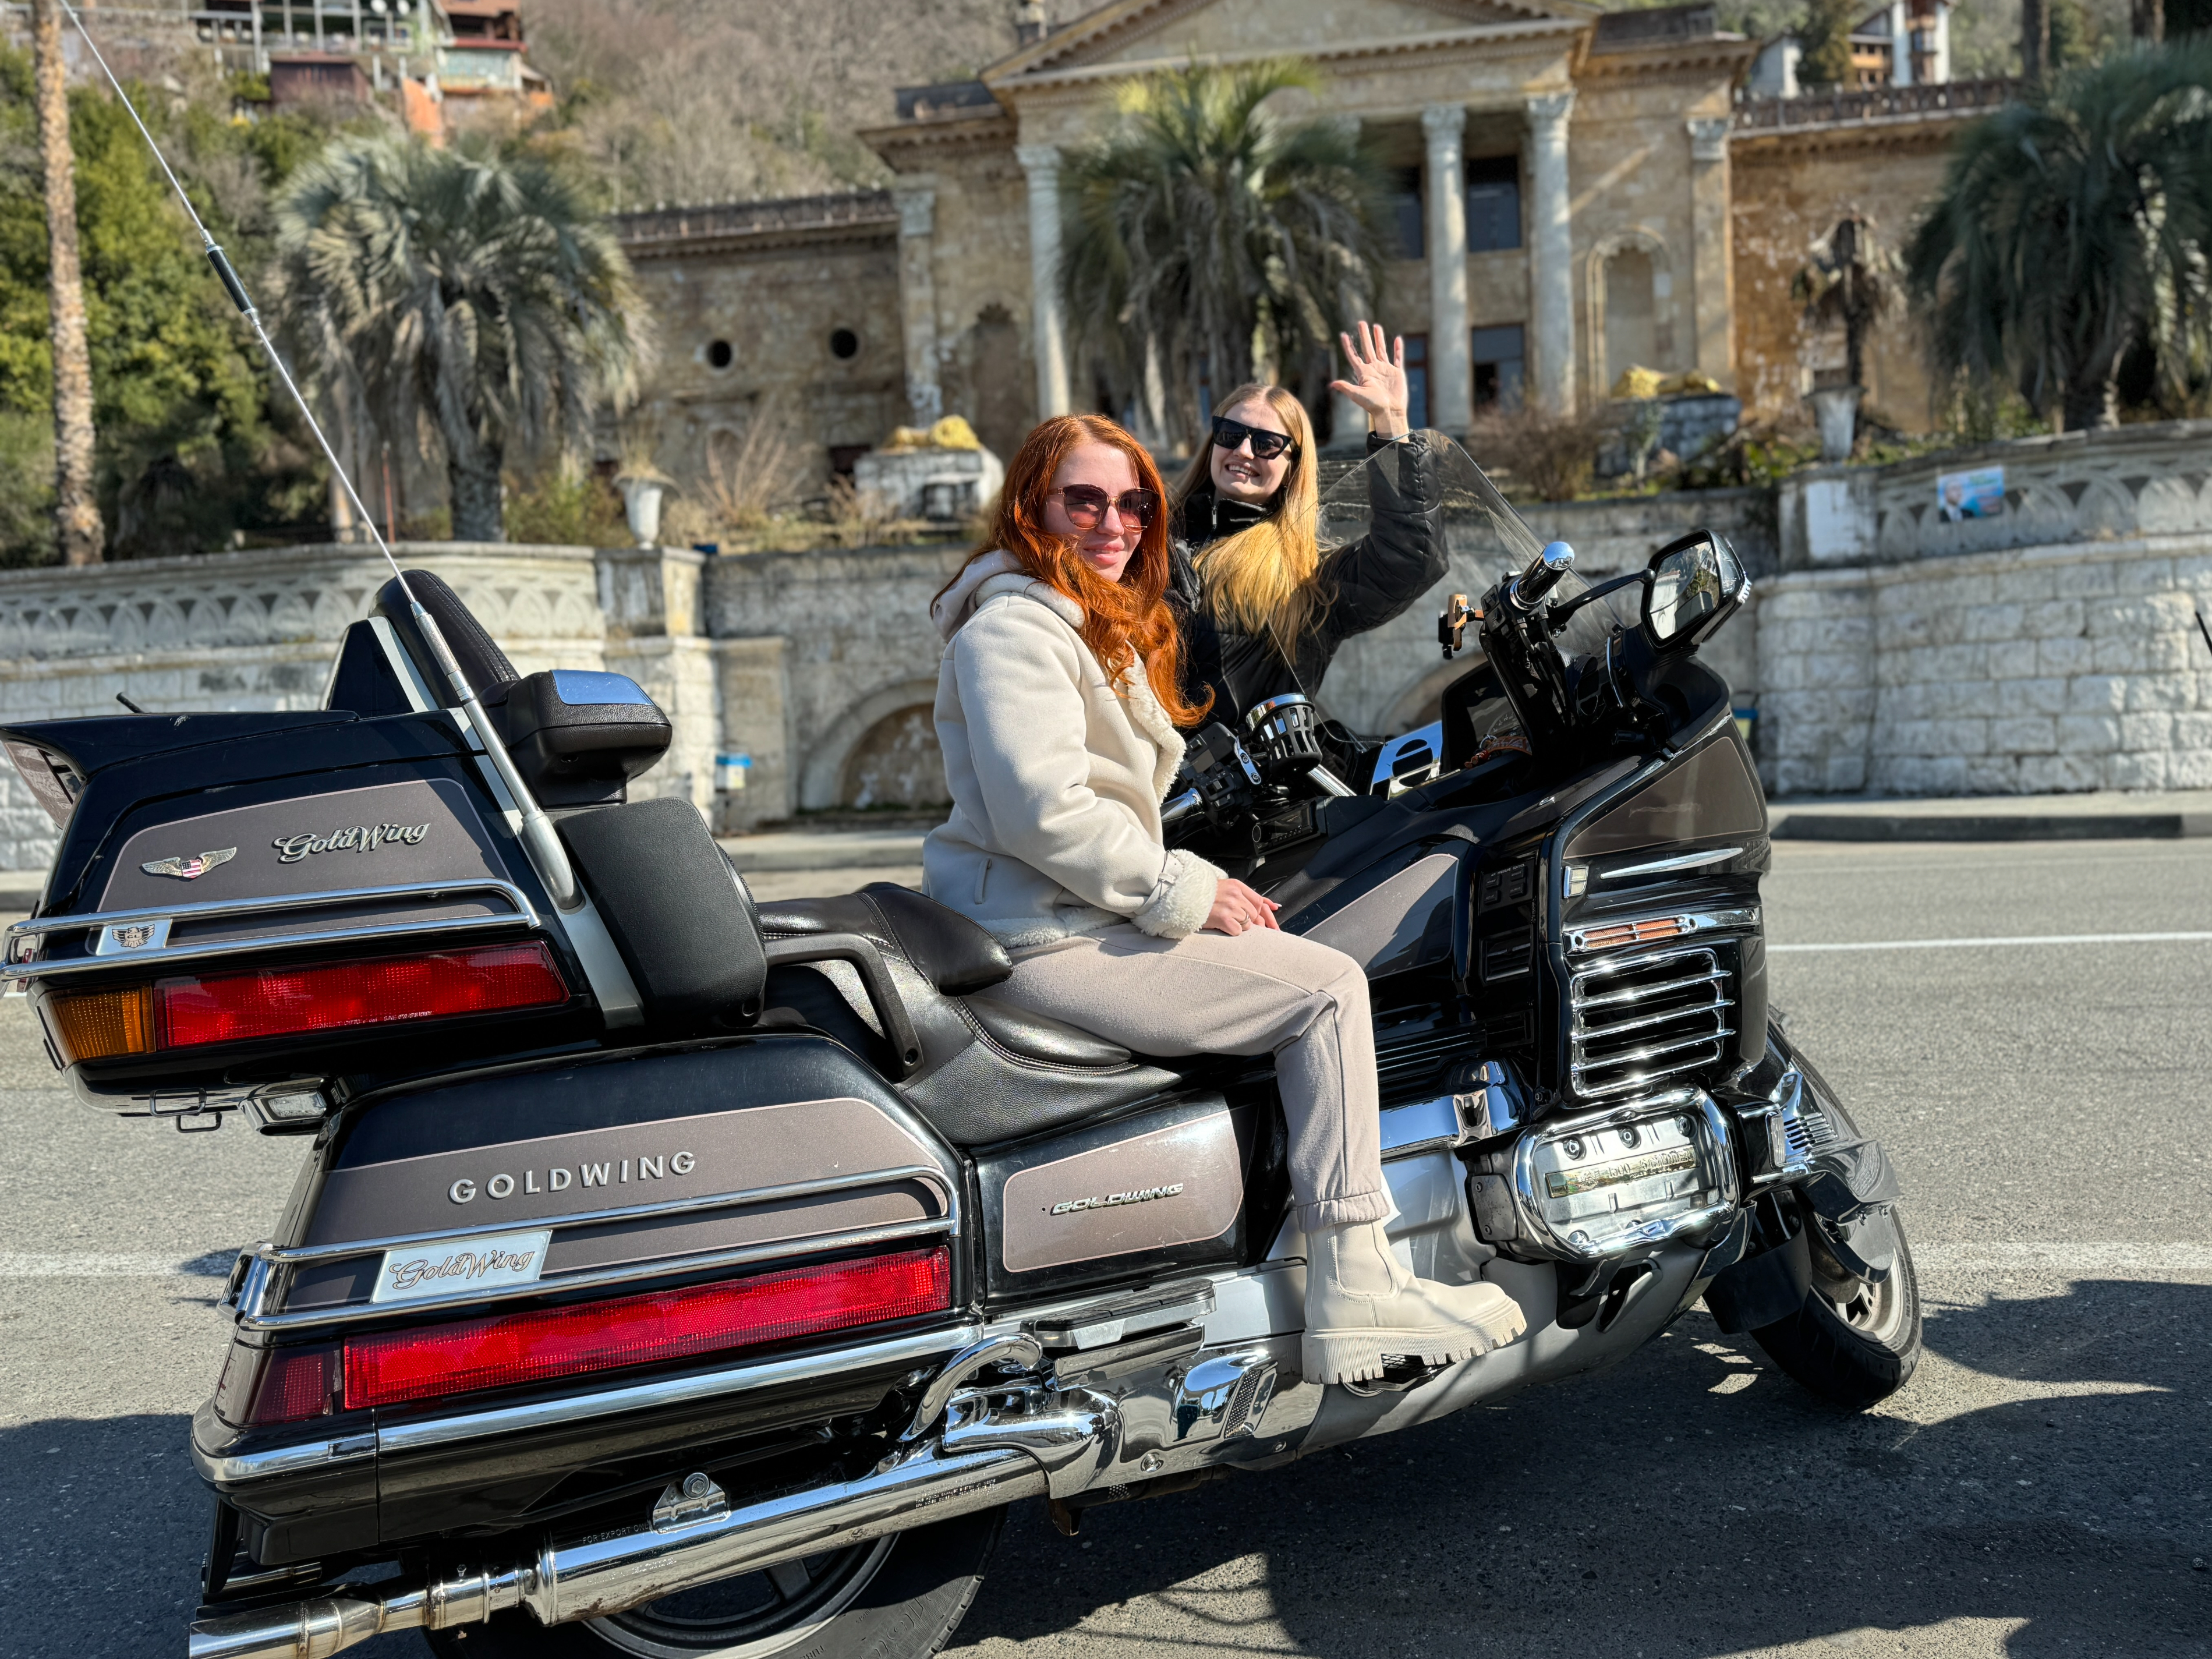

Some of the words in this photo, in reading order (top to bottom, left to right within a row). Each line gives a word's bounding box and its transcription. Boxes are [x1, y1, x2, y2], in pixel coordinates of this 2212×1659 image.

[274, 823, 431, 862] GoldWing
[449, 1151, 696, 1204] GOLDWING
[1051, 1183, 1184, 1215] GOLDWING
[389, 1250, 535, 1290] GoldWing
[582, 1535, 598, 1544] FOR
[600, 1526, 631, 1540] EXPORT
[633, 1523, 650, 1532] ONL
